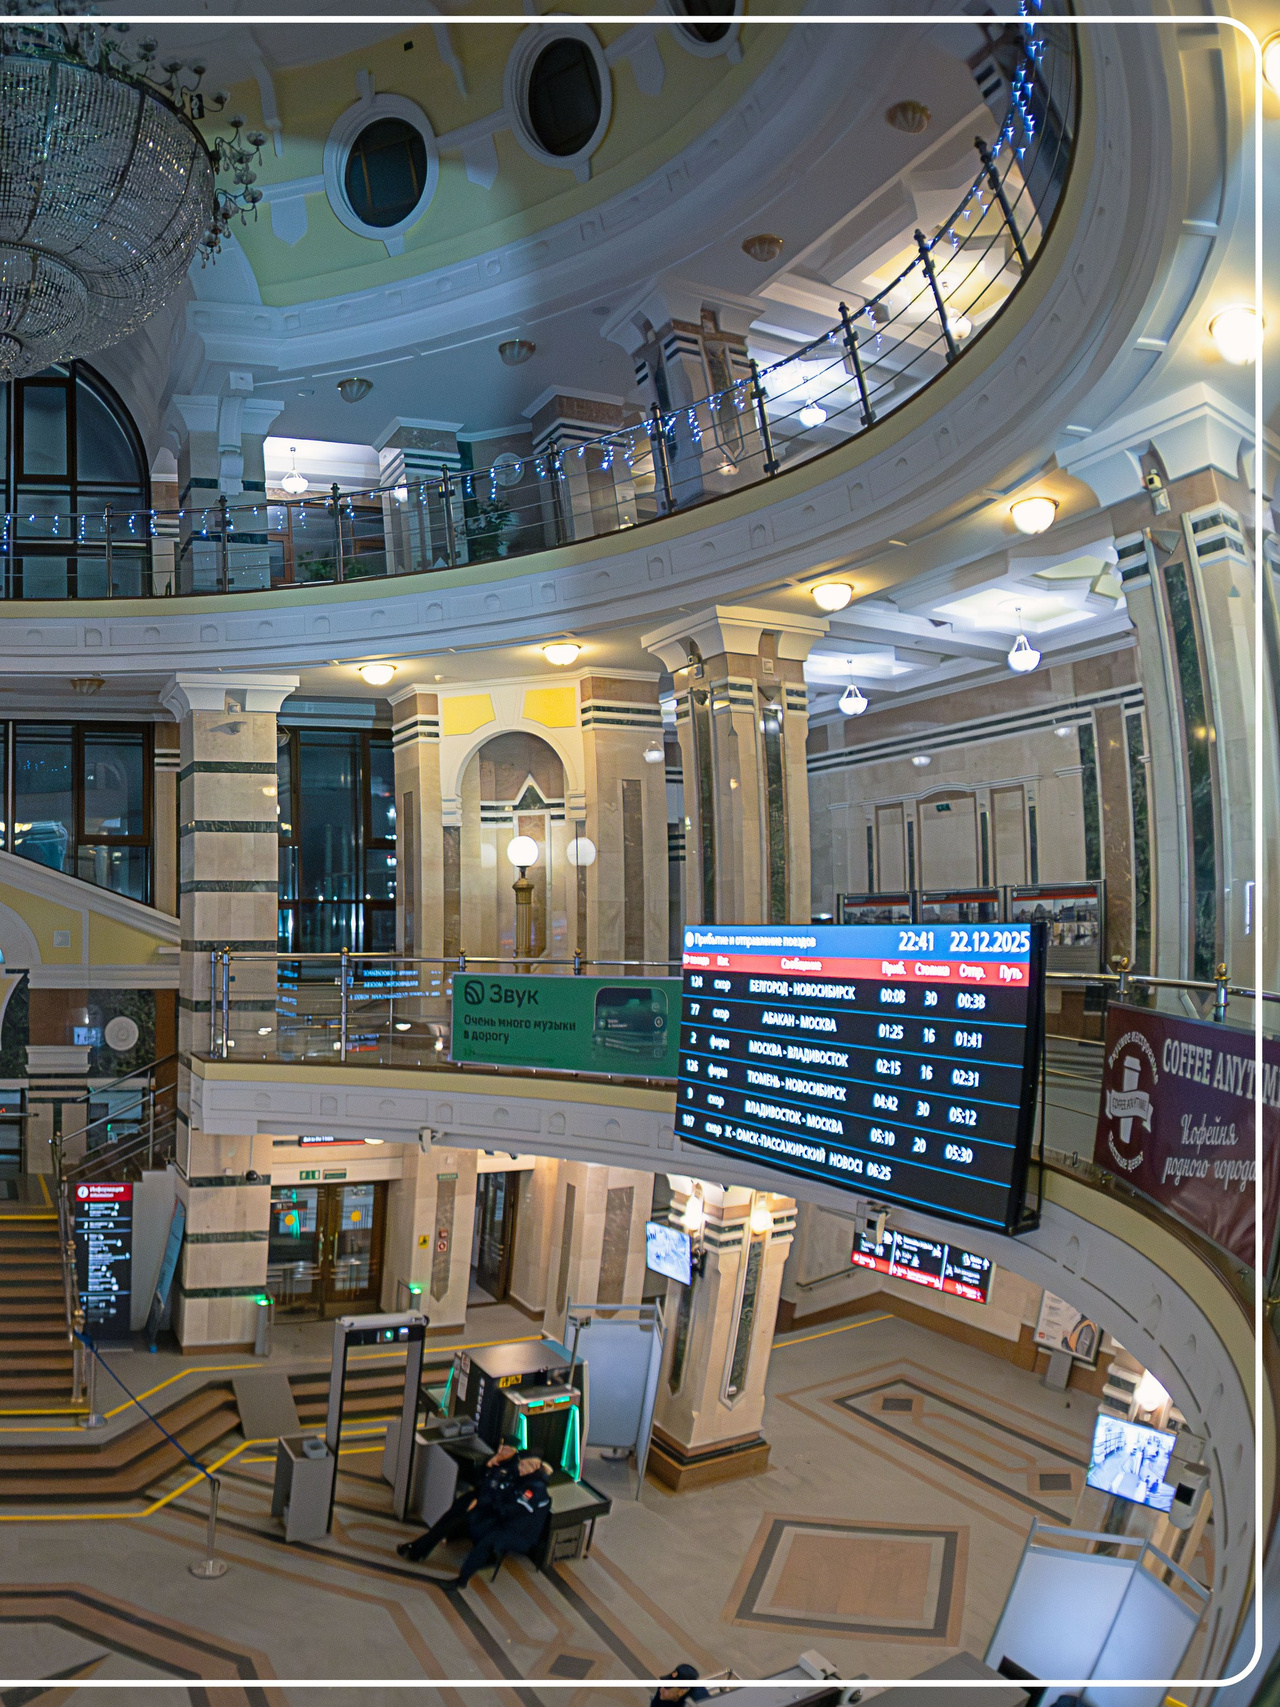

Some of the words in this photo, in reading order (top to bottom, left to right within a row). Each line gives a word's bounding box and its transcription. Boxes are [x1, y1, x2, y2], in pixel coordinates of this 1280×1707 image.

[899, 931, 934, 951] 22:41
[950, 931, 1030, 952] 22.12.2025
[915, 962, 950, 977] Стоянка
[999, 965, 1023, 982] Путь
[489, 984, 539, 1008] Звук
[714, 979, 731, 992] скор
[749, 979, 789, 996] БЕЛГОРОД
[793, 982, 856, 1000] НОВОСИБИРСК
[880, 988, 906, 1004] 00:08
[925, 990, 937, 1006] 30
[957, 992, 986, 1010] 00:38
[464, 1014, 496, 1027] Очень
[498, 1018, 531, 1029] много
[533, 1020, 576, 1033] музыки
[464, 1030, 470, 1039] в
[471, 1031, 510, 1045] дорогу
[691, 1003, 700, 1015] 77
[713, 1008, 730, 1022] скор
[762, 1011, 795, 1027] АБАКАН
[800, 1015, 837, 1032] МОСКВА
[878, 1023, 904, 1040] 01:25
[923, 1028, 936, 1043] 16
[955, 1031, 983, 1049] 01:41
[690, 1031, 697, 1044] 2
[749, 1040, 783, 1057] МОСКВА
[787, 1045, 849, 1067] ВЛАДИВОСТОК
[876, 1058, 901, 1075] 02:15
[921, 1064, 933, 1080] 16
[952, 1068, 980, 1087] 02:31
[1163, 1038, 1213, 1086] COFFEE
[747, 1069, 781, 1088] ТЮМЕНЬ
[785, 1077, 847, 1101] НОВОСИБИРСК
[873, 1093, 898, 1111] 04:42
[917, 1101, 930, 1117] 30
[949, 1106, 977, 1126] 05:12
[745, 1099, 802, 1125] ВЛАДИВОСТОК
[806, 1113, 844, 1135] МОСКВА
[870, 1127, 895, 1146] 05:10
[913, 1137, 926, 1153] 20
[945, 1143, 973, 1163] 05:30
[1181, 1113, 1239, 1155] Кофейня
[736, 1127, 826, 1163] ОМСК-ПАССАЖИРСКИЙ
[866, 1162, 892, 1180] 06:25
[1161, 1156, 1211, 1186] родного
[1214, 1160, 1256, 1192] города
